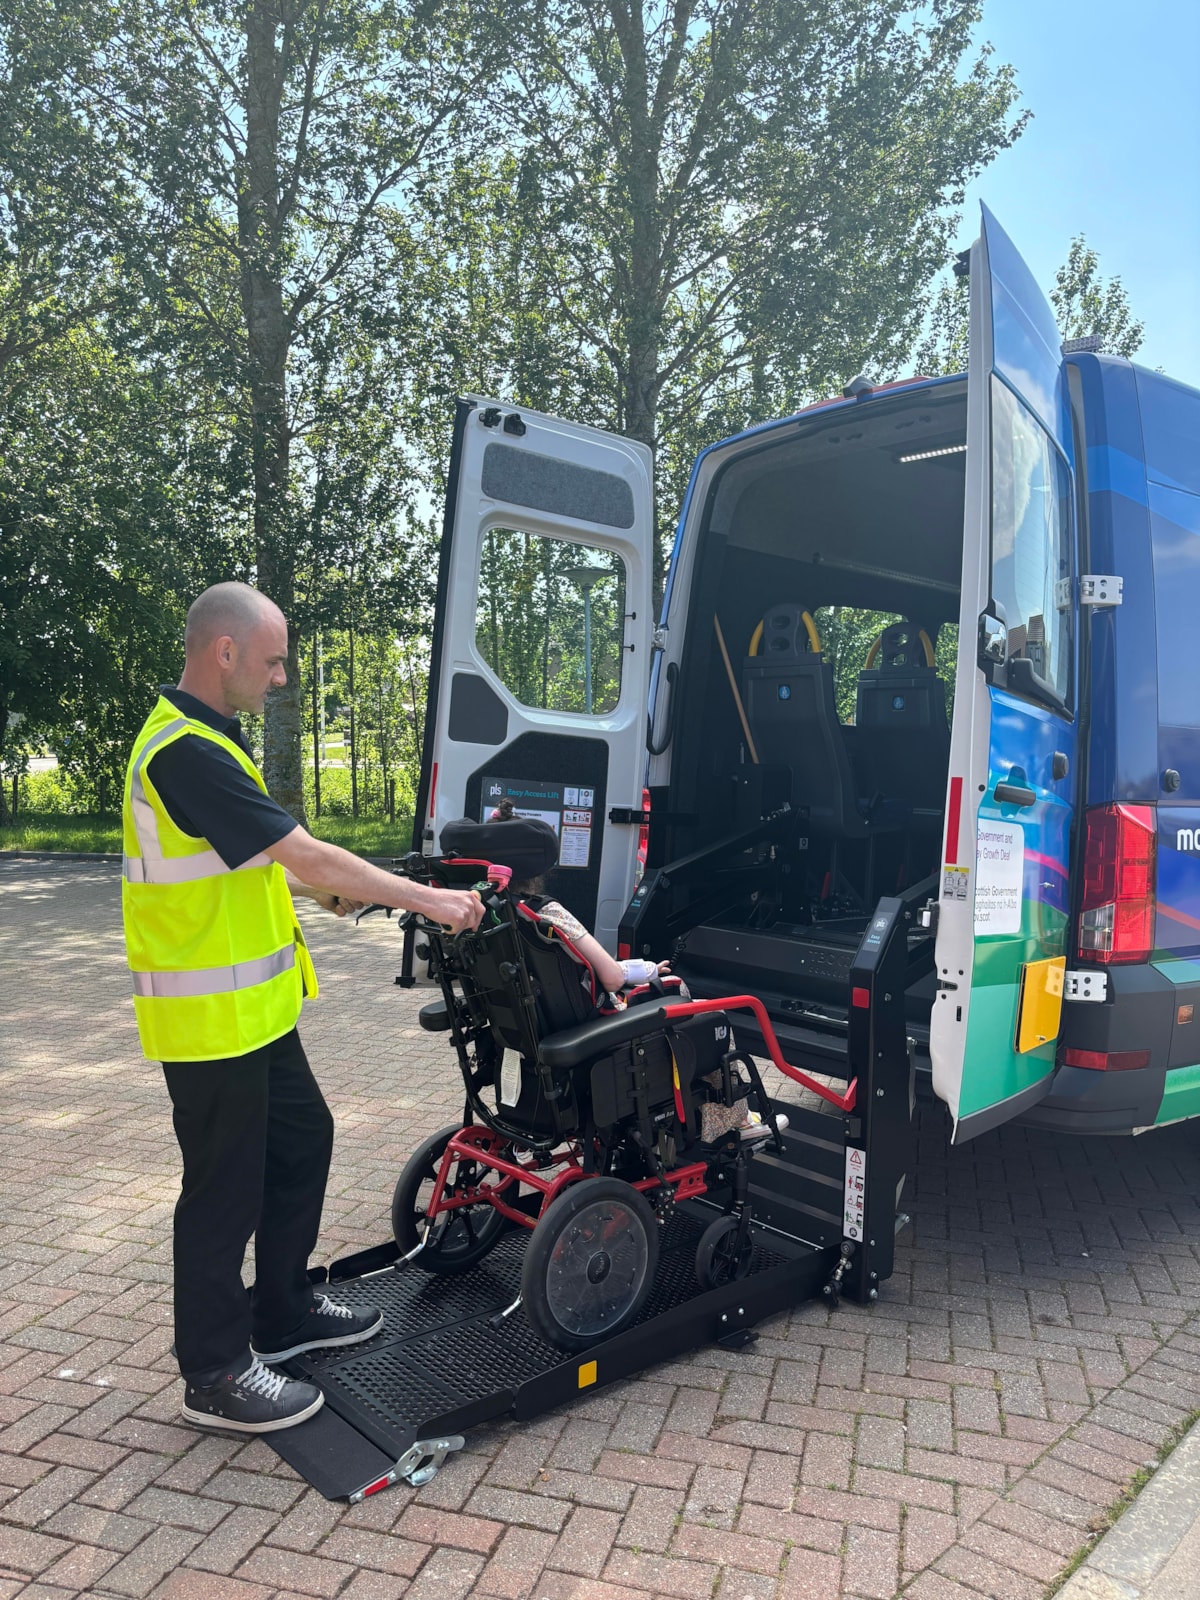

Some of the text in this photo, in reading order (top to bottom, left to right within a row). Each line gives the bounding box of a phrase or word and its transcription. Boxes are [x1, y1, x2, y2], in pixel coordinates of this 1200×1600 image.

[490, 783, 502, 797] pls
[507, 788, 559, 799] Easy Access Lift
[977, 828, 1013, 844] Government and
[983, 847, 1000, 860] Growth
[1000, 849, 1010, 860] Deal
[992, 885, 1018, 897] Government
